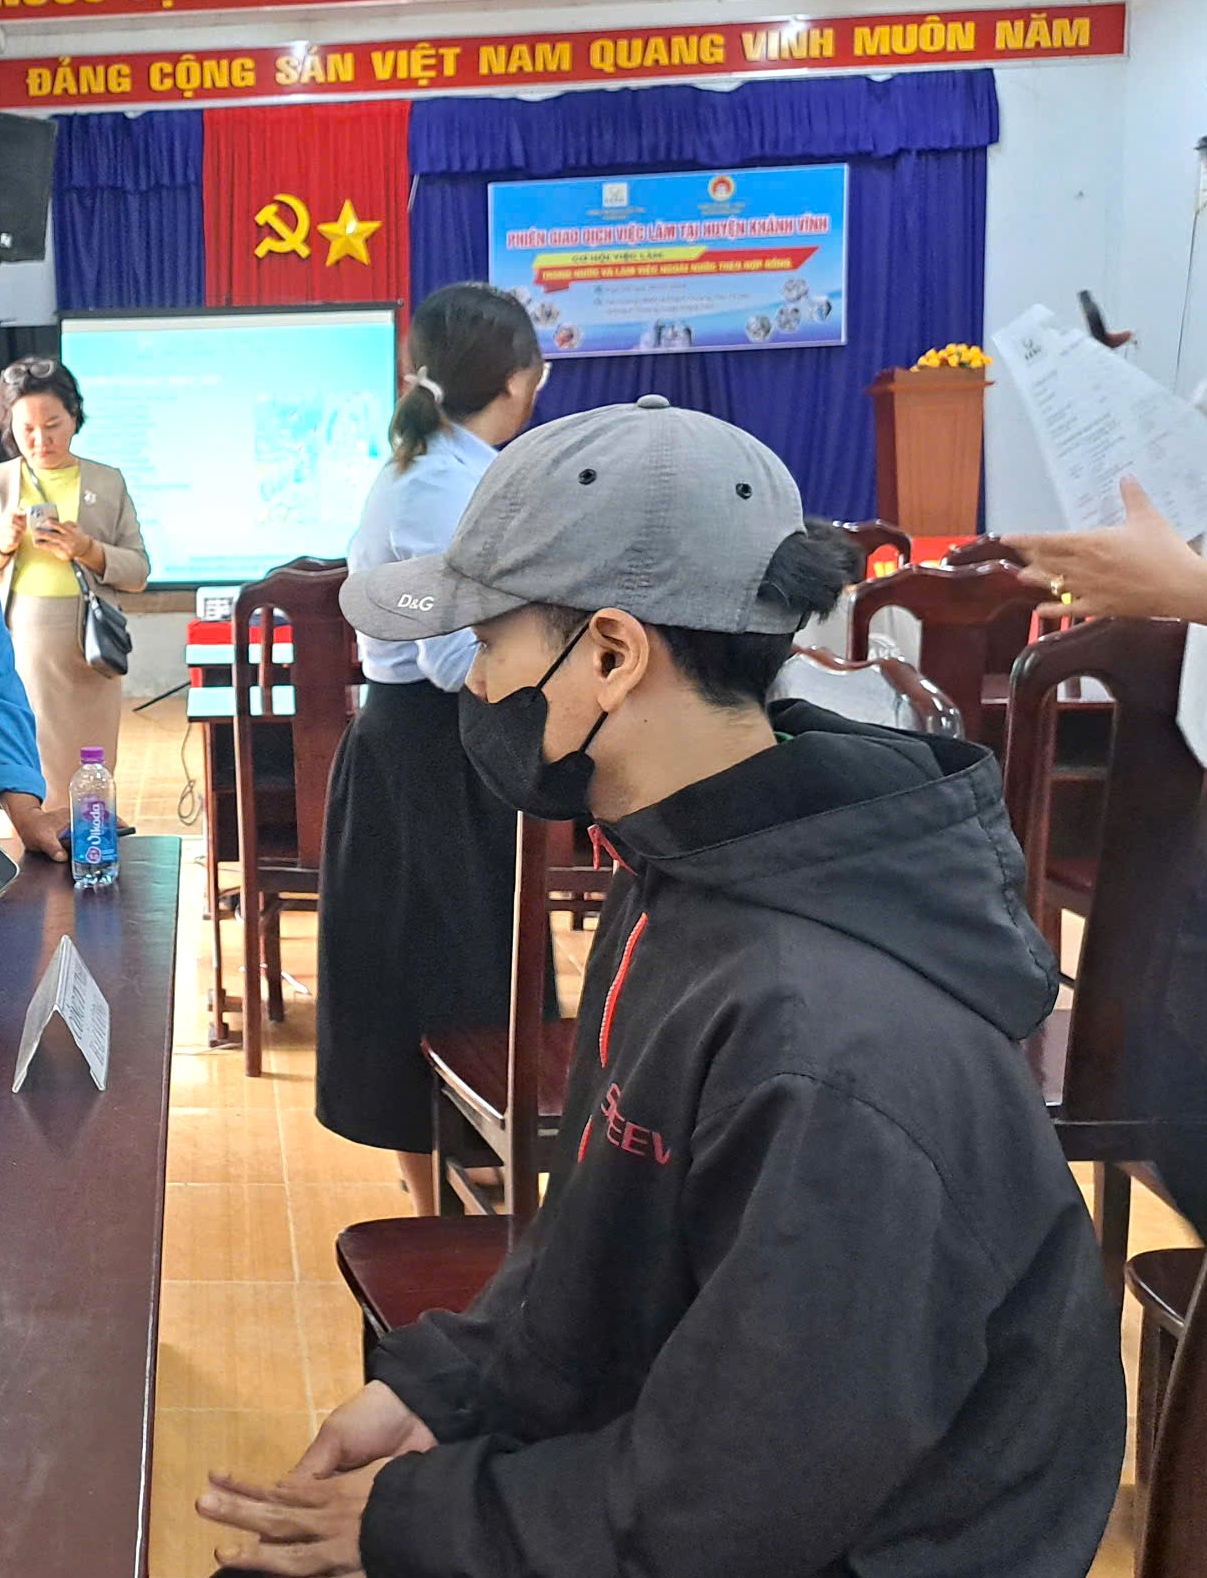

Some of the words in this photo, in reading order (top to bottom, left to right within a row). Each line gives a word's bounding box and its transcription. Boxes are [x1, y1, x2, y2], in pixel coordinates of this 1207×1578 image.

[26, 56, 131, 97] ĐẢNG
[149, 53, 255, 99] CỘNG
[371, 42, 461, 86] VIỆT
[479, 41, 572, 75] NAM
[589, 33, 725, 74] QUANG
[742, 27, 835, 63] VINH
[853, 15, 976, 57] MUÔN
[995, 13, 1091, 50] NĂM
[507, 227, 546, 249] PHIÊN
[550, 228, 579, 248] GIAO
[616, 221, 644, 246] VIỆC
[680, 221, 700, 242] TẠI
[702, 216, 746, 240] HUYỆN
[397, 593, 435, 612] D&G
[86, 803, 102, 845] Vikoda
